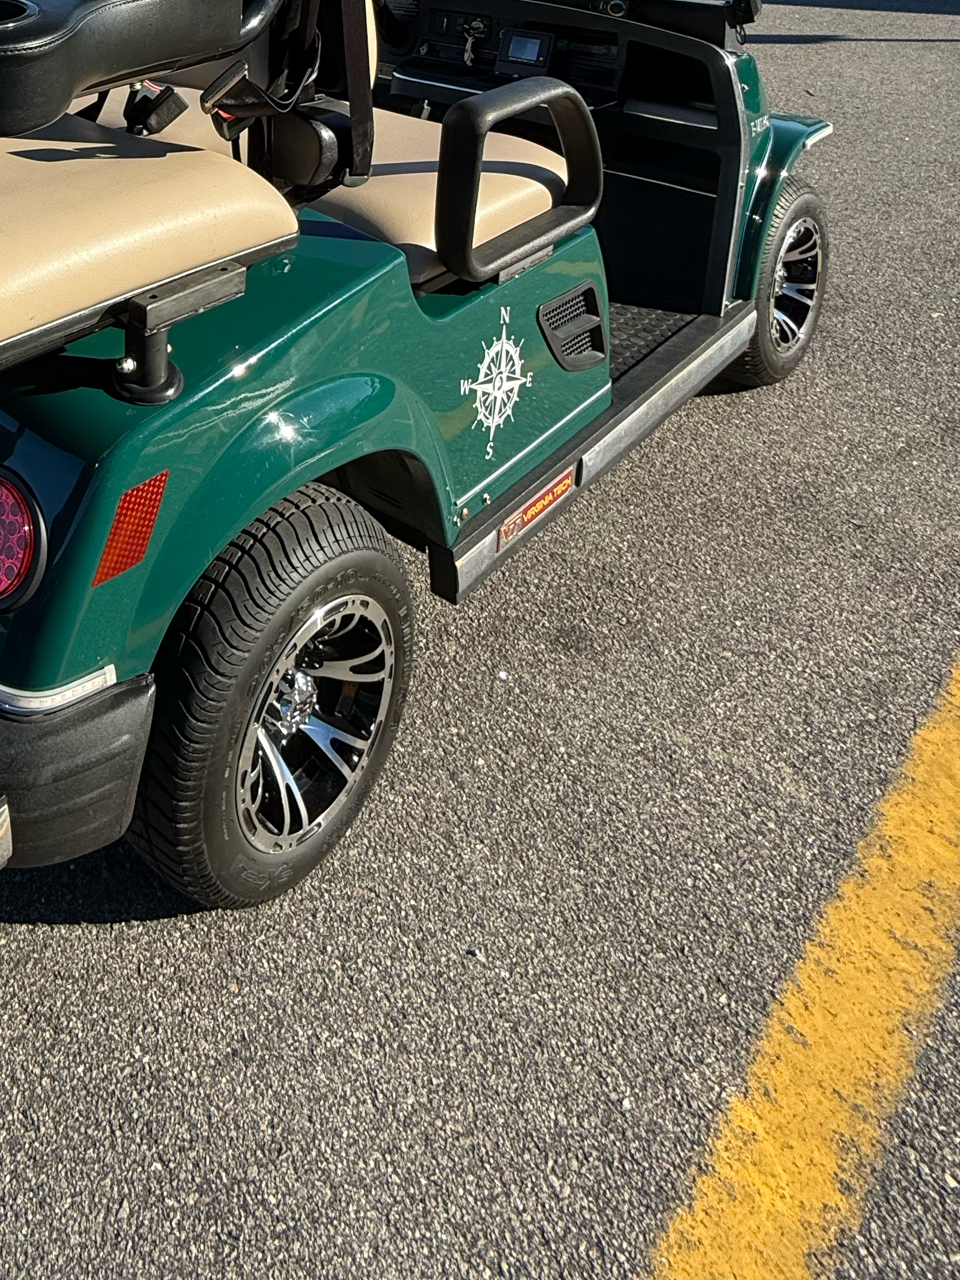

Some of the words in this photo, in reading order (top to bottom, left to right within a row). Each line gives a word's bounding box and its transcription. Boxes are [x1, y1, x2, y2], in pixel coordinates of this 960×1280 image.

[500, 306, 511, 324] N
[460, 378, 472, 395] W
[525, 372, 533, 388] E
[484, 441, 494, 460] S
[553, 475, 572, 498] TECH
